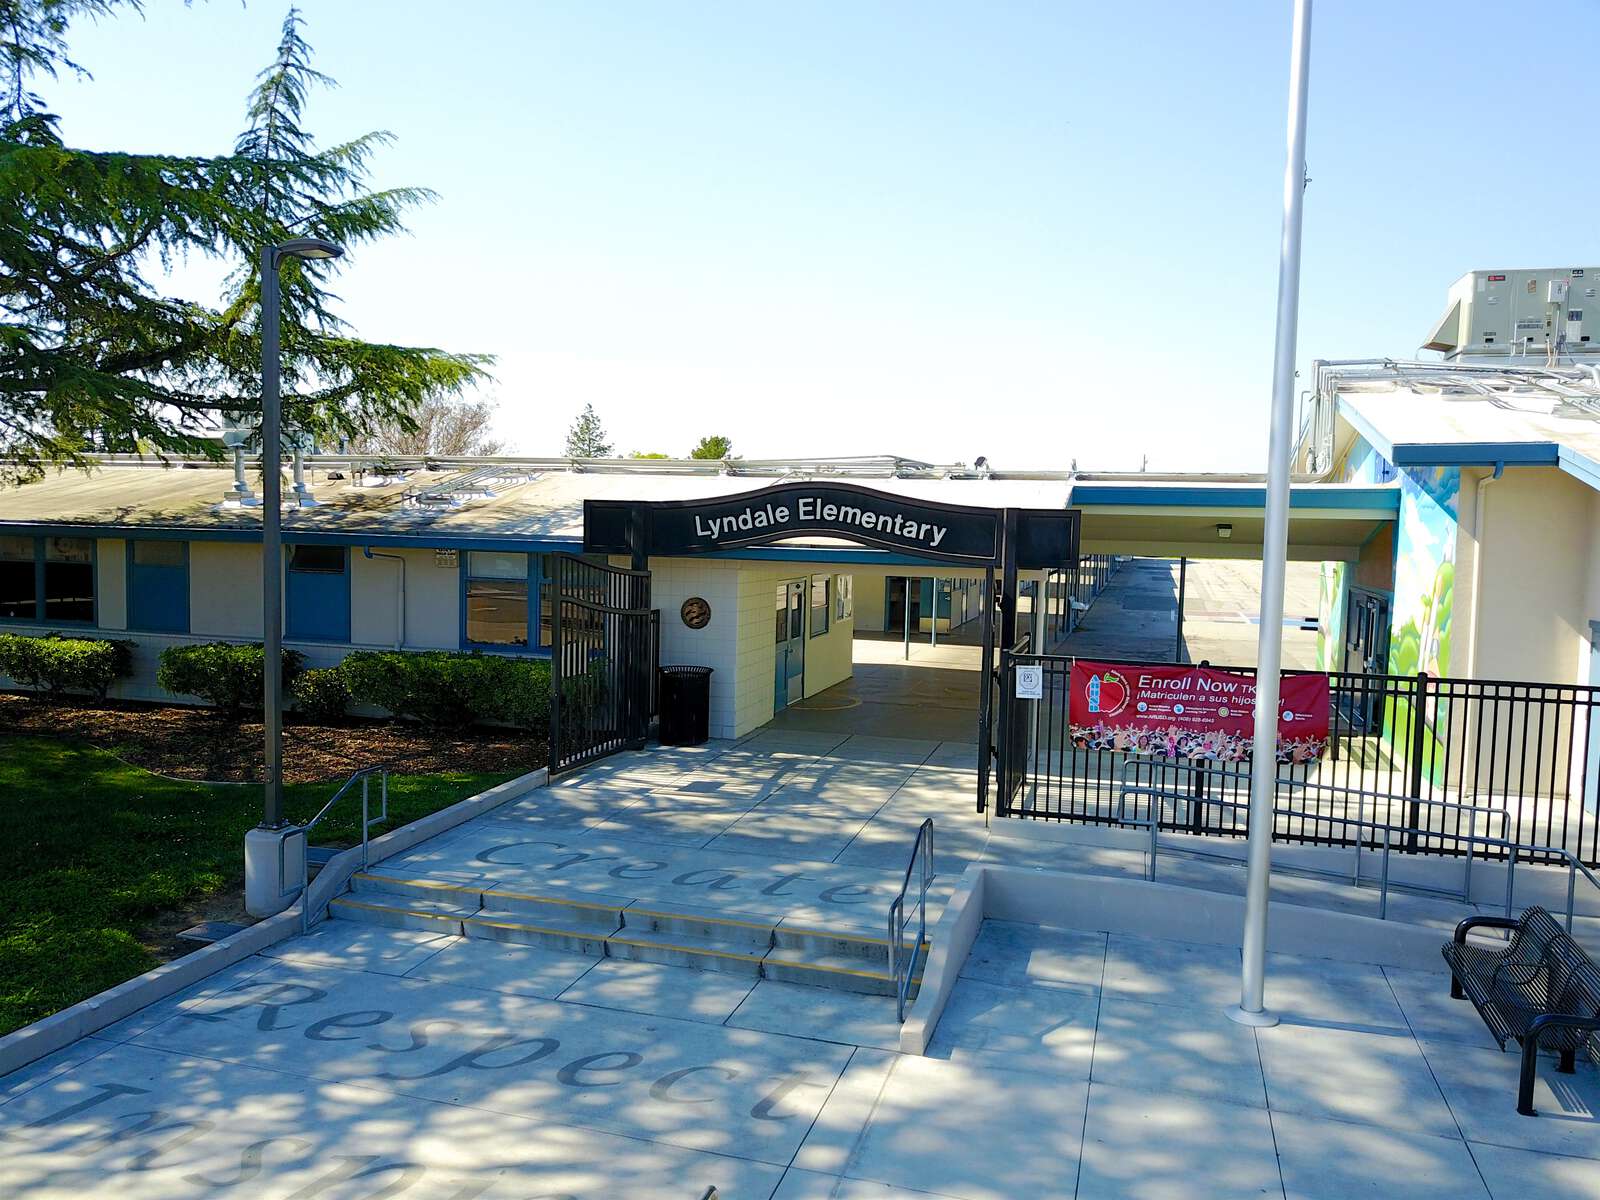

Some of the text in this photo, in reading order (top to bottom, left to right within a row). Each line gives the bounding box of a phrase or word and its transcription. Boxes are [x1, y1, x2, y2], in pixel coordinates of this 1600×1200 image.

[694, 498, 947, 547] Lyndale Elementary
[1136, 690, 1196, 702] ¡Matriculen
[1208, 695, 1229, 704] sus
[1231, 695, 1257, 706] hijos
[1138, 674, 1192, 690] Enroll
[1196, 677, 1238, 693] Now
[475, 841, 877, 904] Create
[180, 982, 828, 1121] Respect
